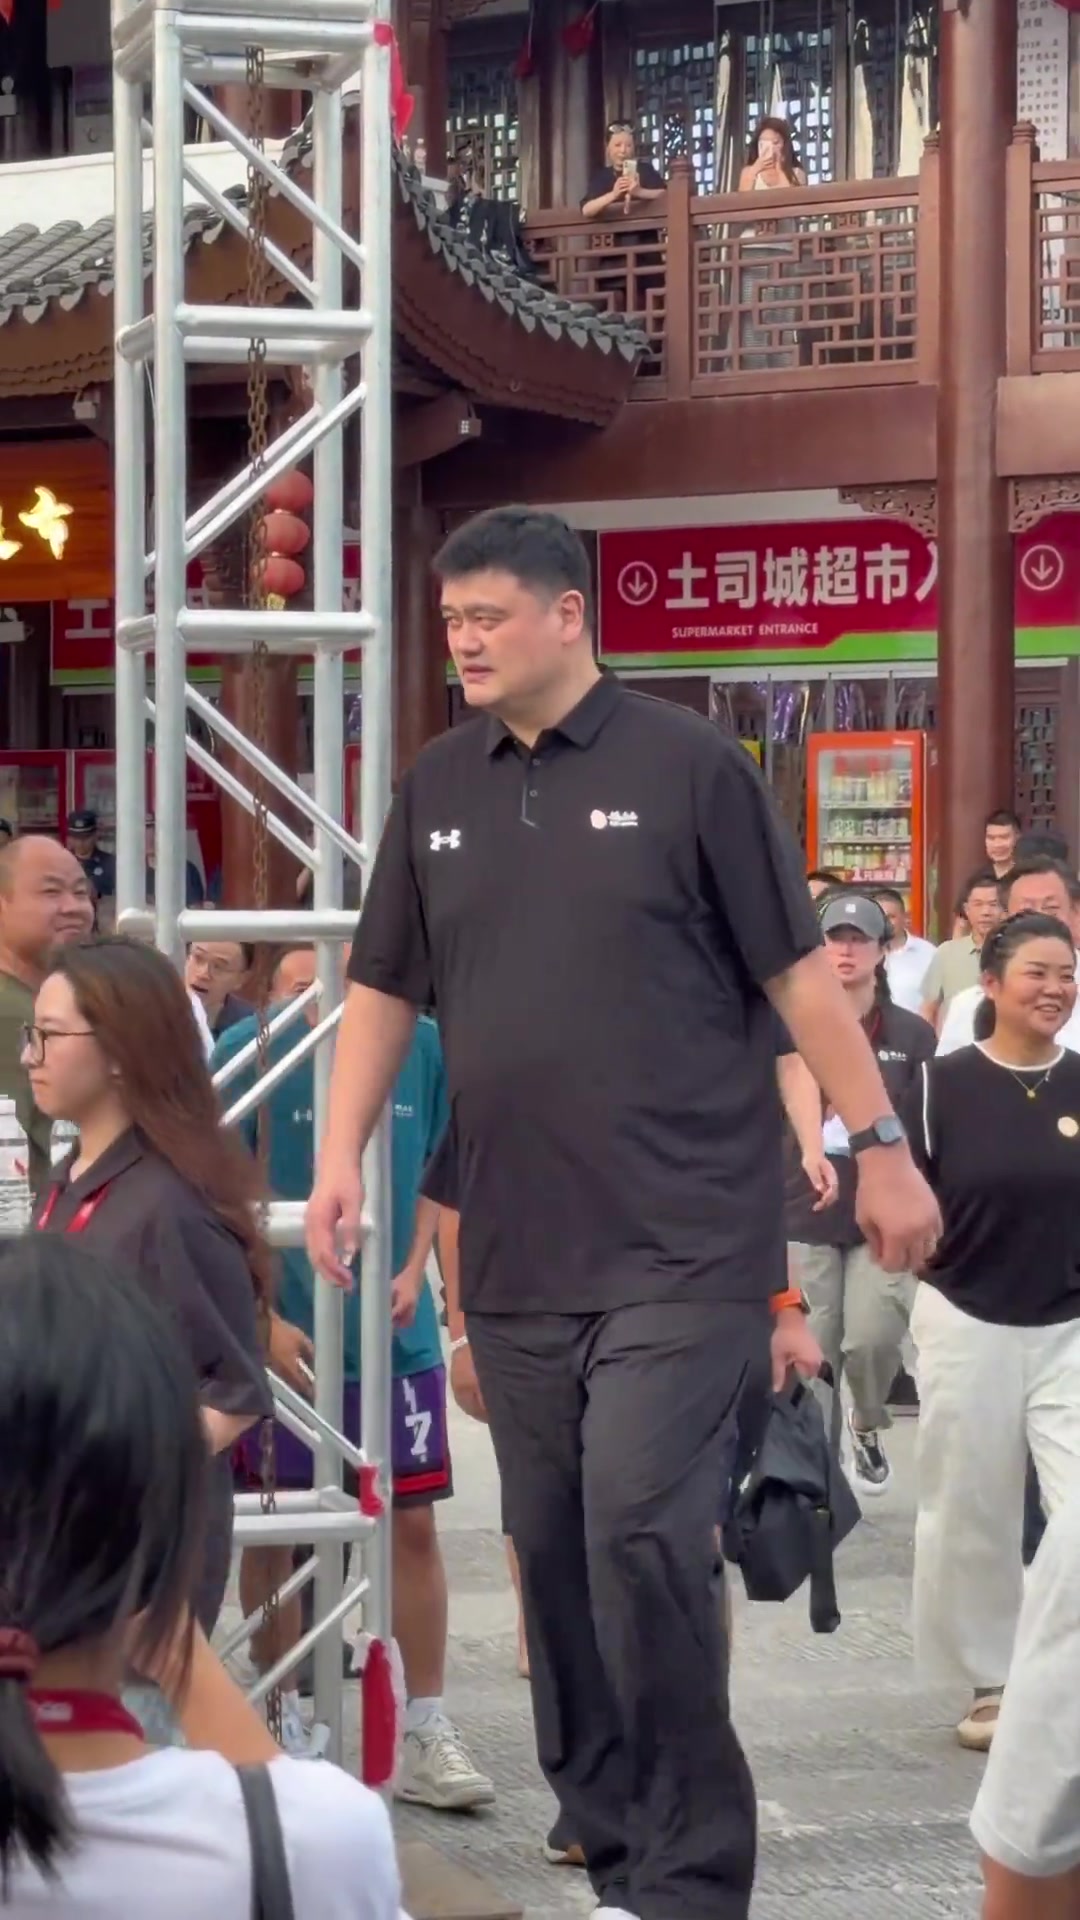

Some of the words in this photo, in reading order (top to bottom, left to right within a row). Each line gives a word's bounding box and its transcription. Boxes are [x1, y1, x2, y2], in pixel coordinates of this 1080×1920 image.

[671, 624, 753, 639] SUPERMARKET
[758, 621, 819, 636] ENTRANCE
[405, 1410, 432, 1456] 7
